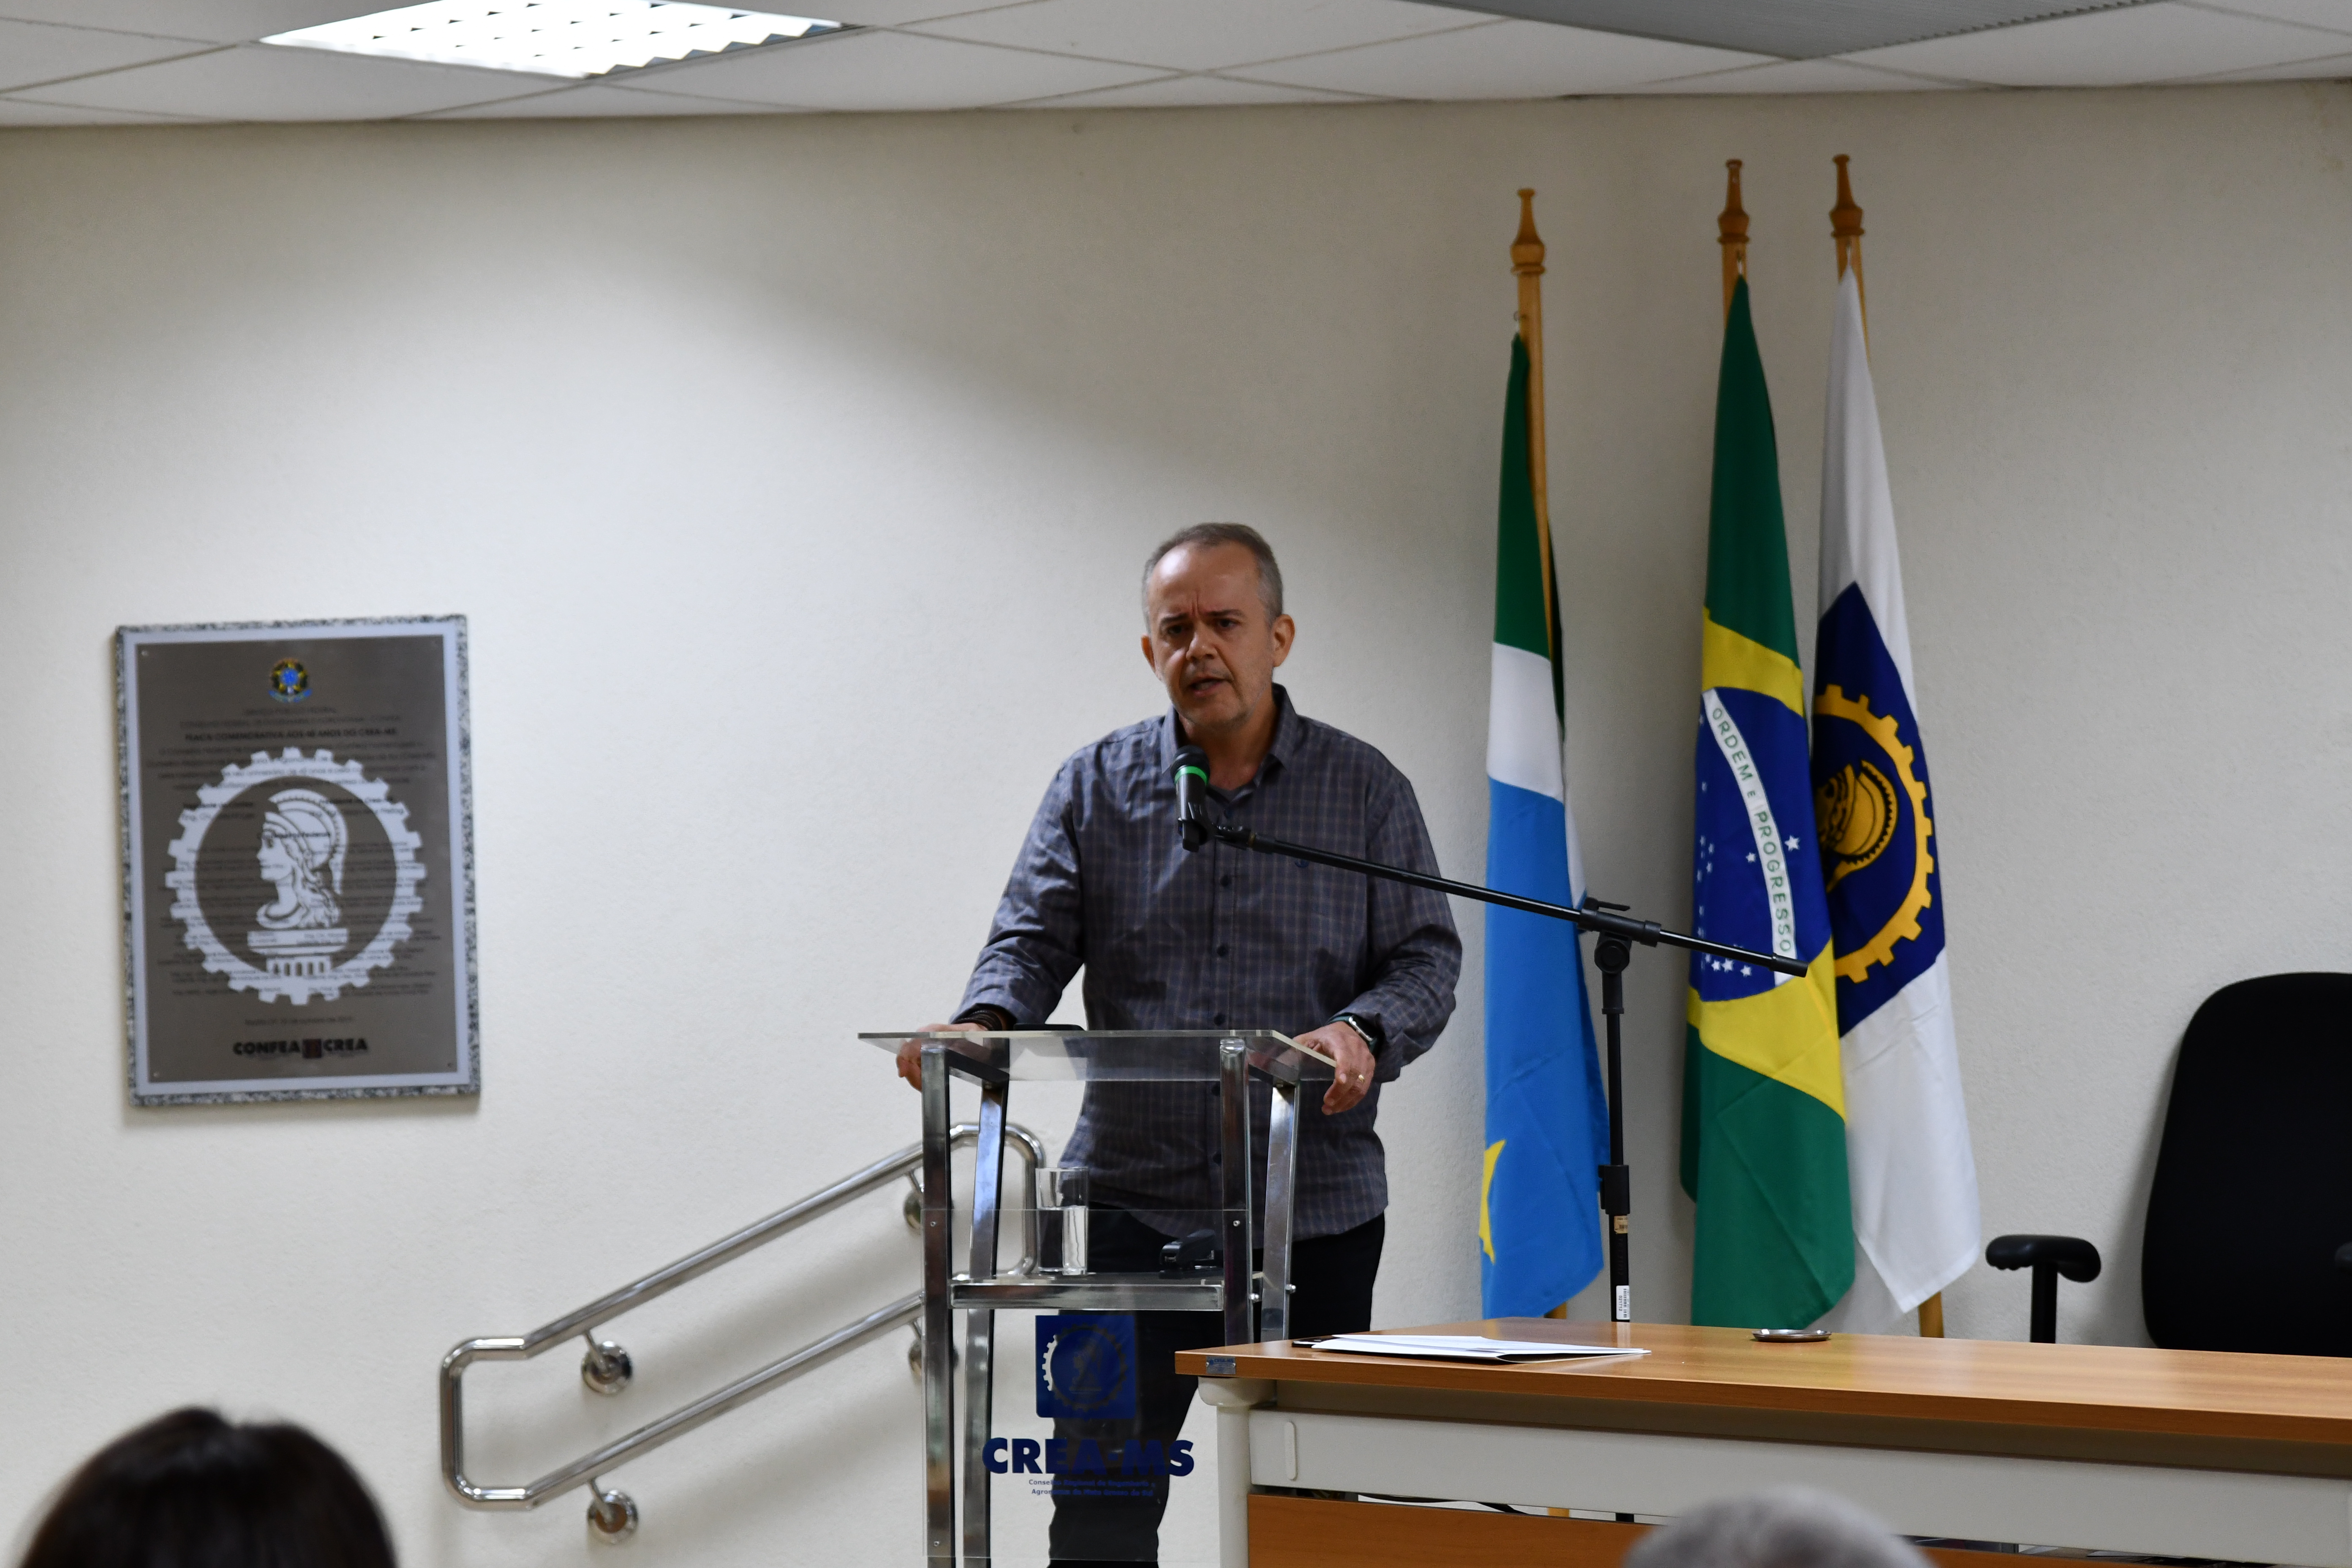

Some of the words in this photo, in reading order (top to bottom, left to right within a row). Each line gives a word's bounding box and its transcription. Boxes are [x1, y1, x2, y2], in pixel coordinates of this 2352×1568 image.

[1712, 708, 1753, 781] ORDEM
[1754, 811, 1791, 951] PROGRESSO
[232, 1040, 300, 1055] CONFEA
[323, 1038, 368, 1052] CREA
[982, 1437, 1195, 1477] CREA-MS
